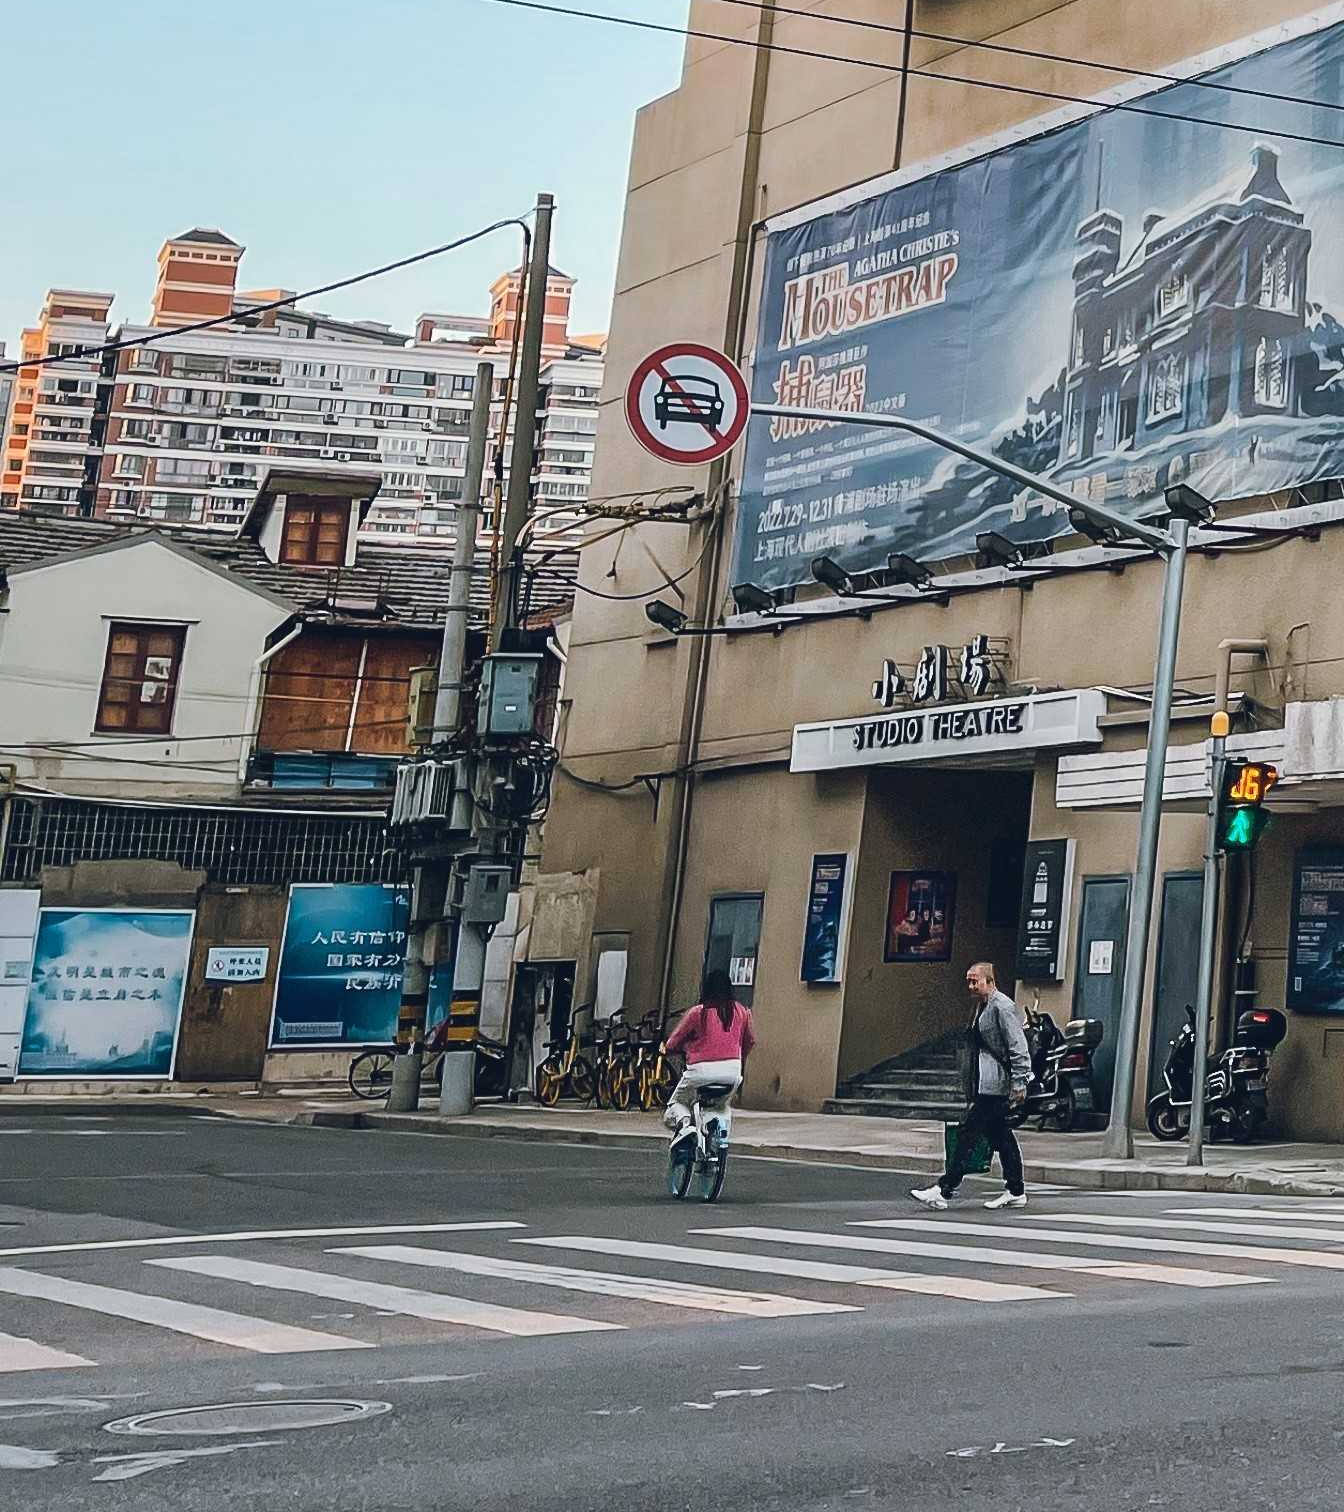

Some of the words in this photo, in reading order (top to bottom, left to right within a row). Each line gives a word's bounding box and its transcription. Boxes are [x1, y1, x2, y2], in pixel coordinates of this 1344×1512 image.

[854, 247, 898, 278] AGATHA
[822, 267, 848, 292] THE
[853, 718, 921, 750] STUDIO
[929, 705, 1021, 741] THEATRE
[327, 953, 408, 967] 国家有力
